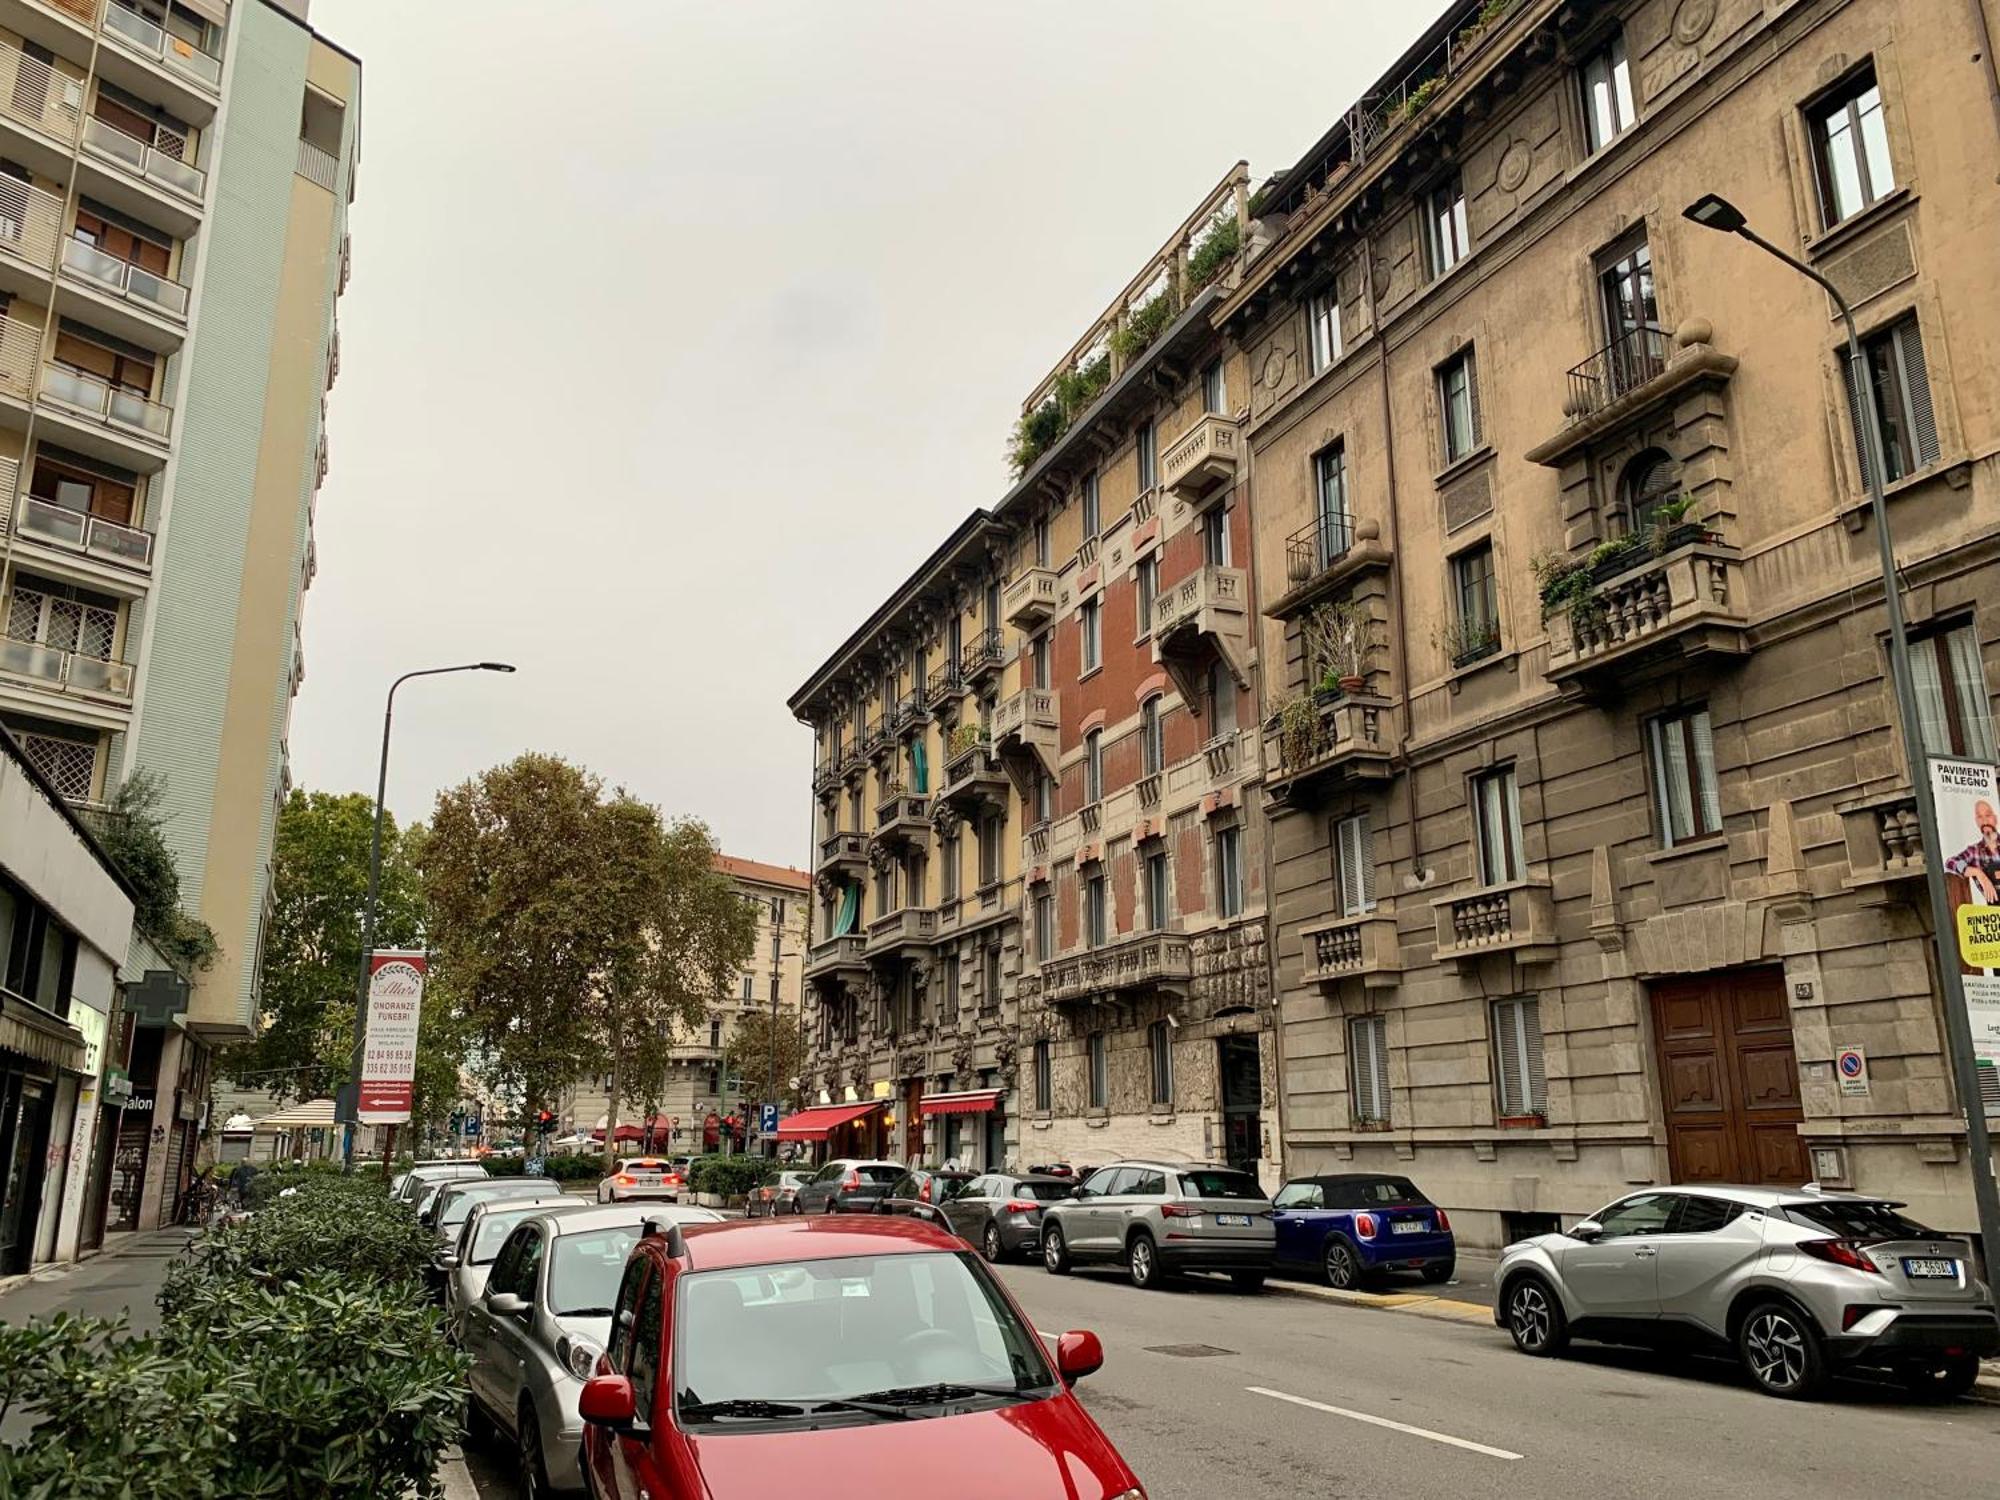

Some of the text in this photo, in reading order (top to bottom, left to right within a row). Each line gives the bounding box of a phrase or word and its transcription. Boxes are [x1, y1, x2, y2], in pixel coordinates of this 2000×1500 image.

[1937, 764, 1990, 778] PAVIMENTI
[1941, 774, 1988, 787] IN LEGNO
[1972, 923, 2000, 934] IL TU
[373, 1002, 416, 1010] ONORANZE
[378, 1012, 410, 1021] FUNEBRI
[764, 1105, 775, 1120] P
